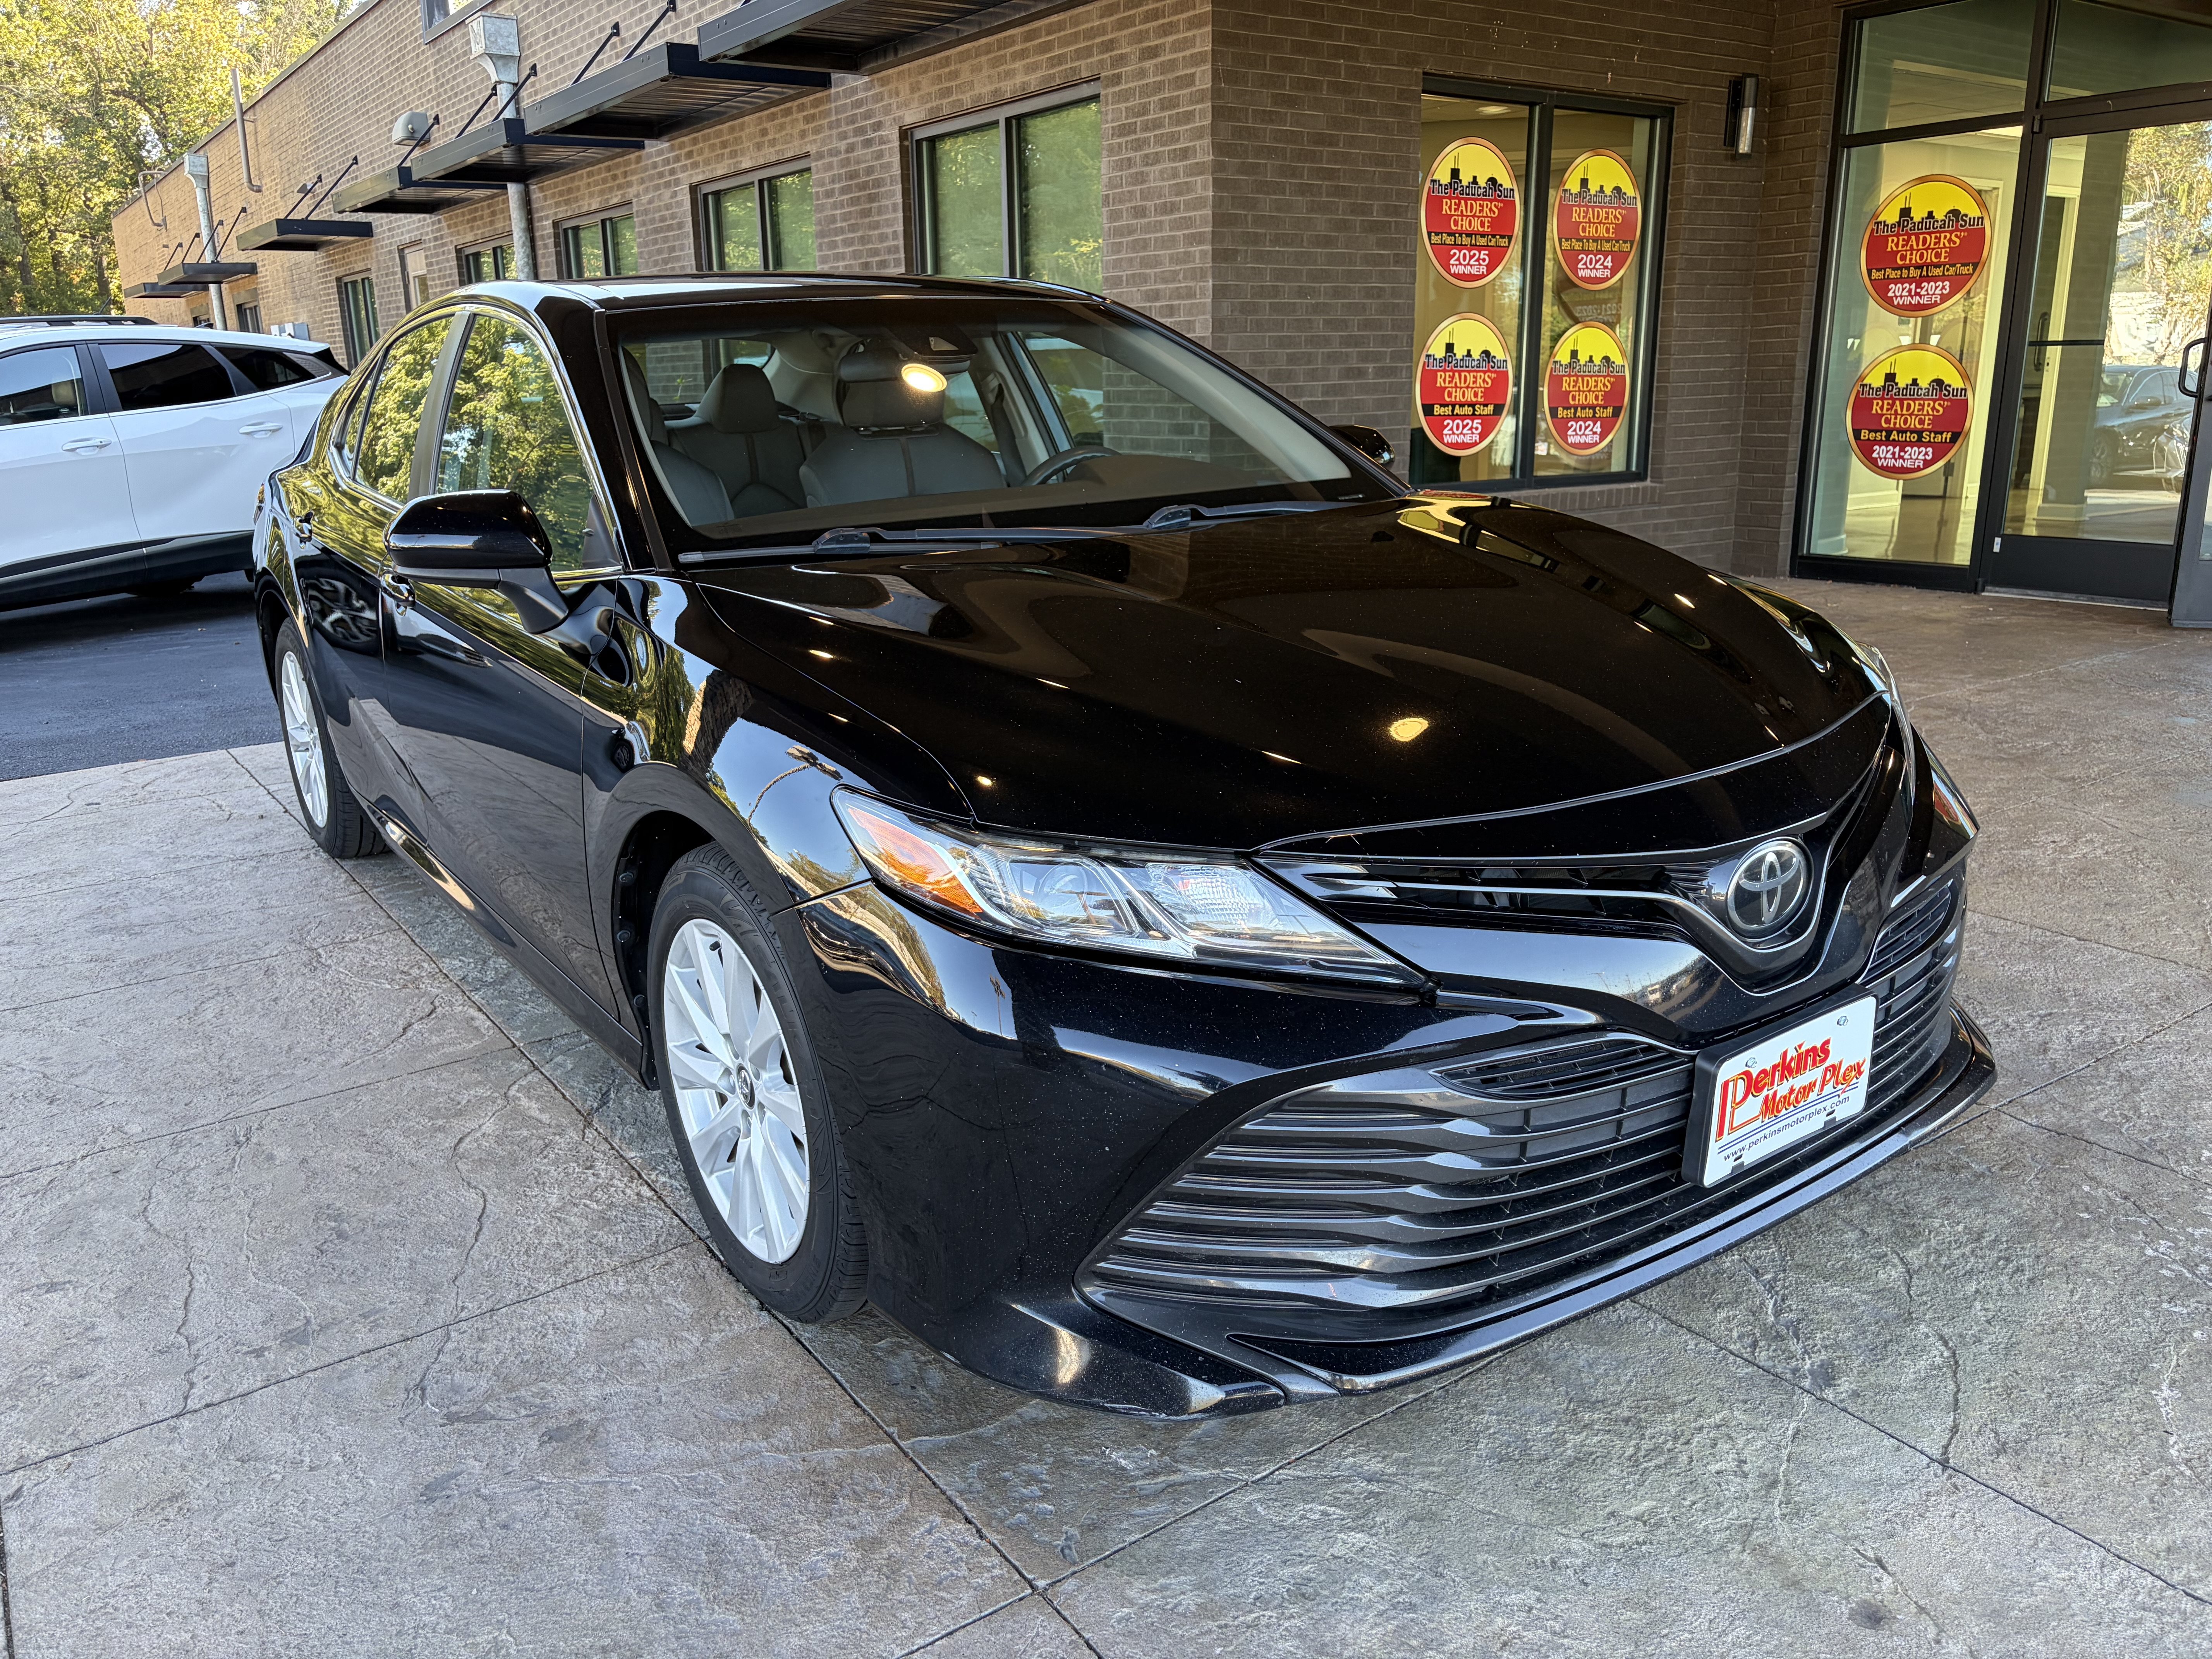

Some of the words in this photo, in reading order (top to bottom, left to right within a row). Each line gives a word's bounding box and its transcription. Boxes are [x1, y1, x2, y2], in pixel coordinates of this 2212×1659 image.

[1430, 179, 1449, 195] The
[1452, 180, 1494, 198] Paducah
[1497, 184, 1515, 199] Sun
[1561, 188, 1579, 204] The
[1581, 189, 1619, 206] Paducah
[1621, 192, 1637, 207] Sun
[1450, 216, 1491, 231] CHOICE
[1579, 223, 1615, 237] CHOICE
[1873, 220, 1897, 235] The
[1900, 214, 1955, 233] Paducah
[1959, 213, 1985, 229] Sun
[1431, 233, 1441, 244] Best
[1442, 233, 1454, 244] Place
[1455, 234, 1461, 244] To
[1462, 234, 1471, 247] Buy
[1472, 235, 1475, 245] A
[1476, 235, 1487, 246] Used
[1562, 239, 1571, 249] Best
[1571, 239, 1582, 250] Place
[1583, 239, 1588, 250] To
[1589, 239, 1597, 252] Buy
[1597, 240, 1601, 251] A
[1602, 240, 1611, 251] Used
[1449, 249, 1489, 265] 2025
[1578, 254, 1613, 269] 2024
[1897, 248, 1949, 264] CHOICE
[1450, 265, 1487, 275] WINNER
[1578, 269, 1611, 278] WINNER
[1871, 269, 1884, 280] Best
[1885, 268, 1900, 279] Place
[1902, 268, 1908, 278] to
[1909, 267, 1921, 279] Buy
[1922, 266, 1926, 276] A
[1928, 265, 1942, 276] Used
[1944, 263, 1973, 276] Car/Truck
[1887, 281, 1950, 297] 2021-2023
[1893, 295, 1941, 305] WINNER
[1425, 353, 1445, 369] The
[1446, 353, 1487, 370] Paducah
[1490, 355, 1508, 370] Sun
[1552, 359, 1569, 375] The
[1570, 359, 1607, 375] Paducah
[1609, 361, 1625, 375] Sun
[1444, 388, 1484, 402] CHOICE
[1569, 392, 1604, 404] CHOICE
[1859, 383, 1882, 398] The
[1885, 383, 1939, 399] Paducah
[1942, 383, 1967, 399] Sun
[1434, 404, 1452, 415] Best
[1454, 404, 1473, 415] Auto
[1475, 404, 1494, 415] Staff
[1558, 407, 1574, 418] Best
[1576, 407, 1593, 417] Auto
[1595, 406, 1613, 417] Staff
[1443, 419, 1482, 434] 2025
[1567, 421, 1601, 435] 2024
[1881, 415, 1933, 429] CHOICE
[1443, 434, 1479, 443] WINNER
[1567, 435, 1599, 443] WINNER
[1860, 429, 1886, 441] Best
[1889, 430, 1918, 441] Auto
[1922, 431, 1952, 442] Staff
[1872, 445, 1933, 460] 2021-2023
[1877, 458, 1923, 468] WINNER
[1715, 1037, 1832, 1143] Perkins
[1759, 1077, 1818, 1123] Motor
[1817, 1057, 1867, 1097] Plex
[1724, 1095, 1850, 1161] www.perkinsmotorplex.com
